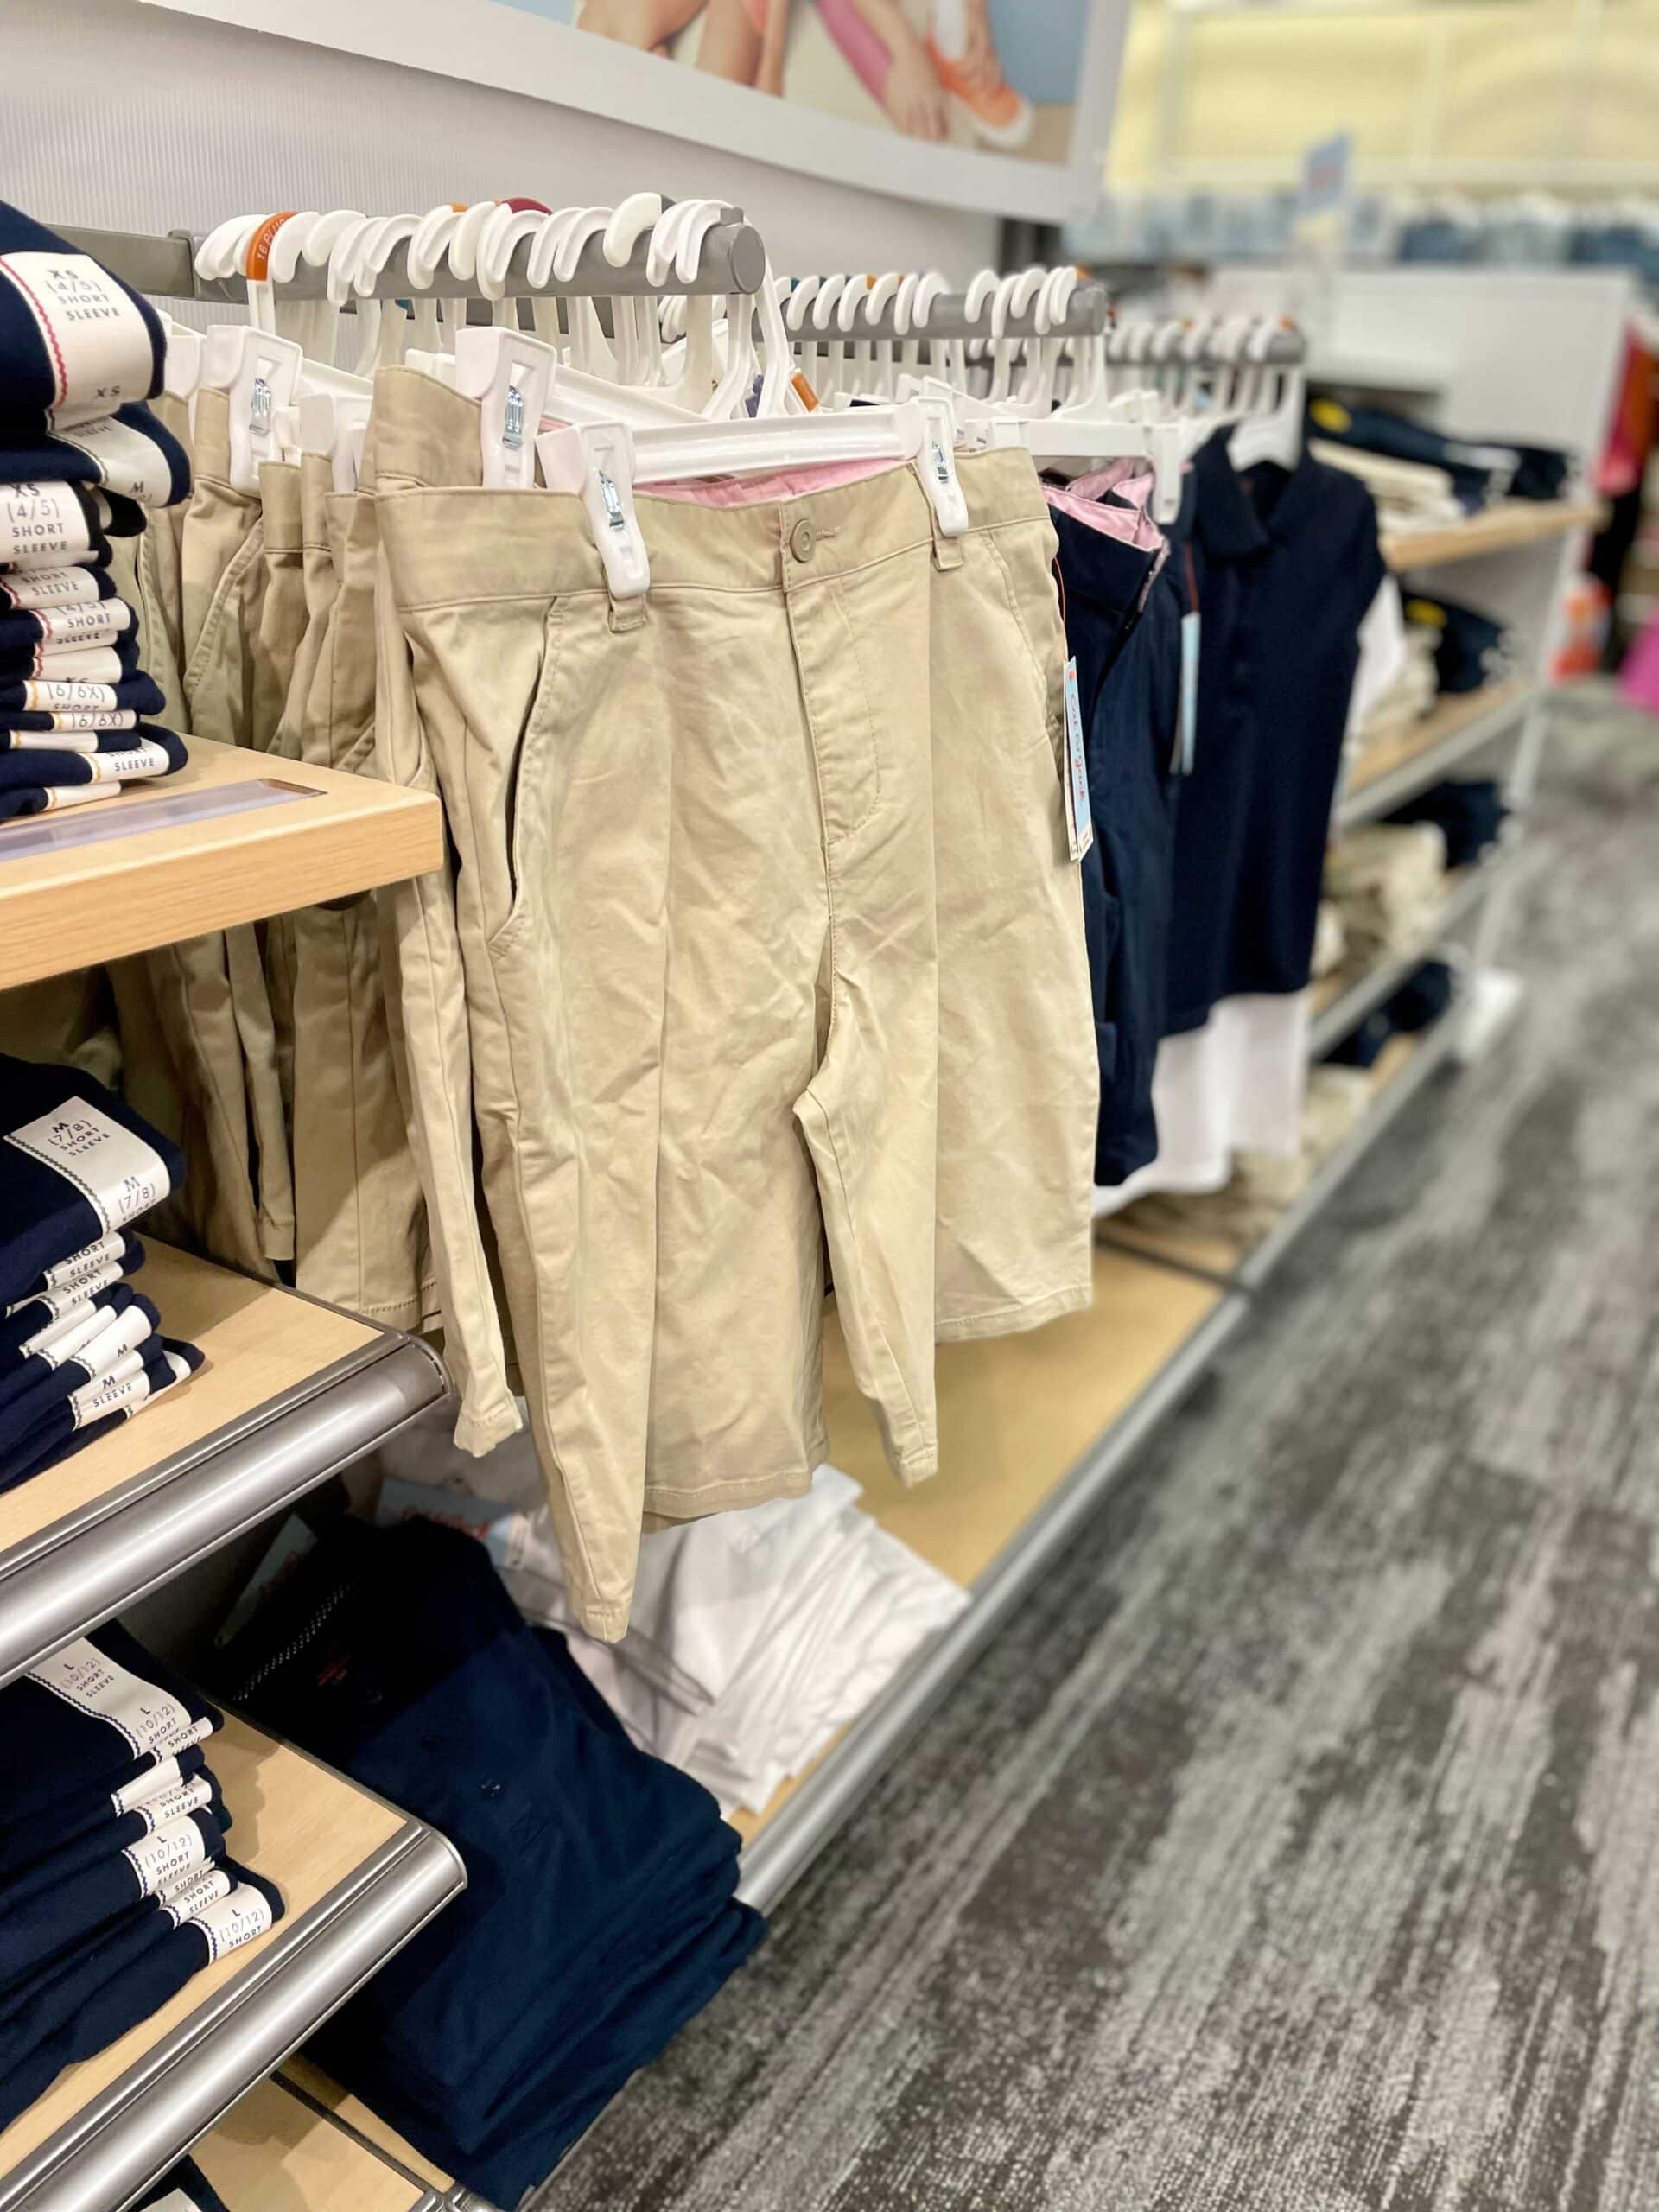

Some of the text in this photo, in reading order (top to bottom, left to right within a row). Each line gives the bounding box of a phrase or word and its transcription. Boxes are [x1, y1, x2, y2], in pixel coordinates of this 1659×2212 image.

[47, 269, 79, 279] XS
[46, 279, 102, 294] (4/5)
[58, 293, 111, 305] SHORT
[66, 307, 122, 321] SLEEVE
[94, 385, 121, 398] XS
[10, 483, 41, 498] XS
[130, 480, 145, 493] M
[7, 498, 60, 523] (4/5)
[12, 523, 64, 537] SHORT
[13, 541, 68, 555] SLEEVE
[20, 571, 68, 584] SHORT
[31, 581, 79, 597] SLEEVE
[67, 613, 111, 629] SHORT
[47, 683, 105, 703] (6/6X)
[71, 711, 124, 729] (6/6X)
[114, 757, 156, 772] SLEEVE
[48, 1119, 92, 1146] (7/8)
[52, 1122, 70, 1134] M
[60, 1127, 99, 1150] SHORT
[68, 1133, 111, 1156] SLEEVE
[124, 1176, 140, 1192] M
[118, 1183, 156, 1214] (7/8)
[64, 1241, 105, 1264] SHORT
[69, 1253, 110, 1277] SLEEVE
[62, 1268, 102, 1294] SHORT
[71, 1279, 108, 1306] SLEEVE
[117, 1343, 128, 1358] M
[102, 1375, 116, 1390] M
[92, 1382, 132, 1408] SLEEVE
[136, 1702, 175, 1738] (10/12)
[140, 1707, 151, 1715] L
[149, 1717, 176, 1744] SHORT
[168, 1726, 198, 1747] SHORT
[160, 1788, 194, 1807] SHORT
[164, 1796, 199, 1819] SLEEVE
[144, 1834, 193, 1867] (10/12)
[156, 1851, 190, 1875] SHORT
[175, 1869, 204, 1891] SHORT
[183, 1880, 215, 1904] SHORT
[231, 1908, 240, 1917] L
[219, 1908, 264, 1942] (10/12)
[228, 1925, 262, 1948] SHORT
